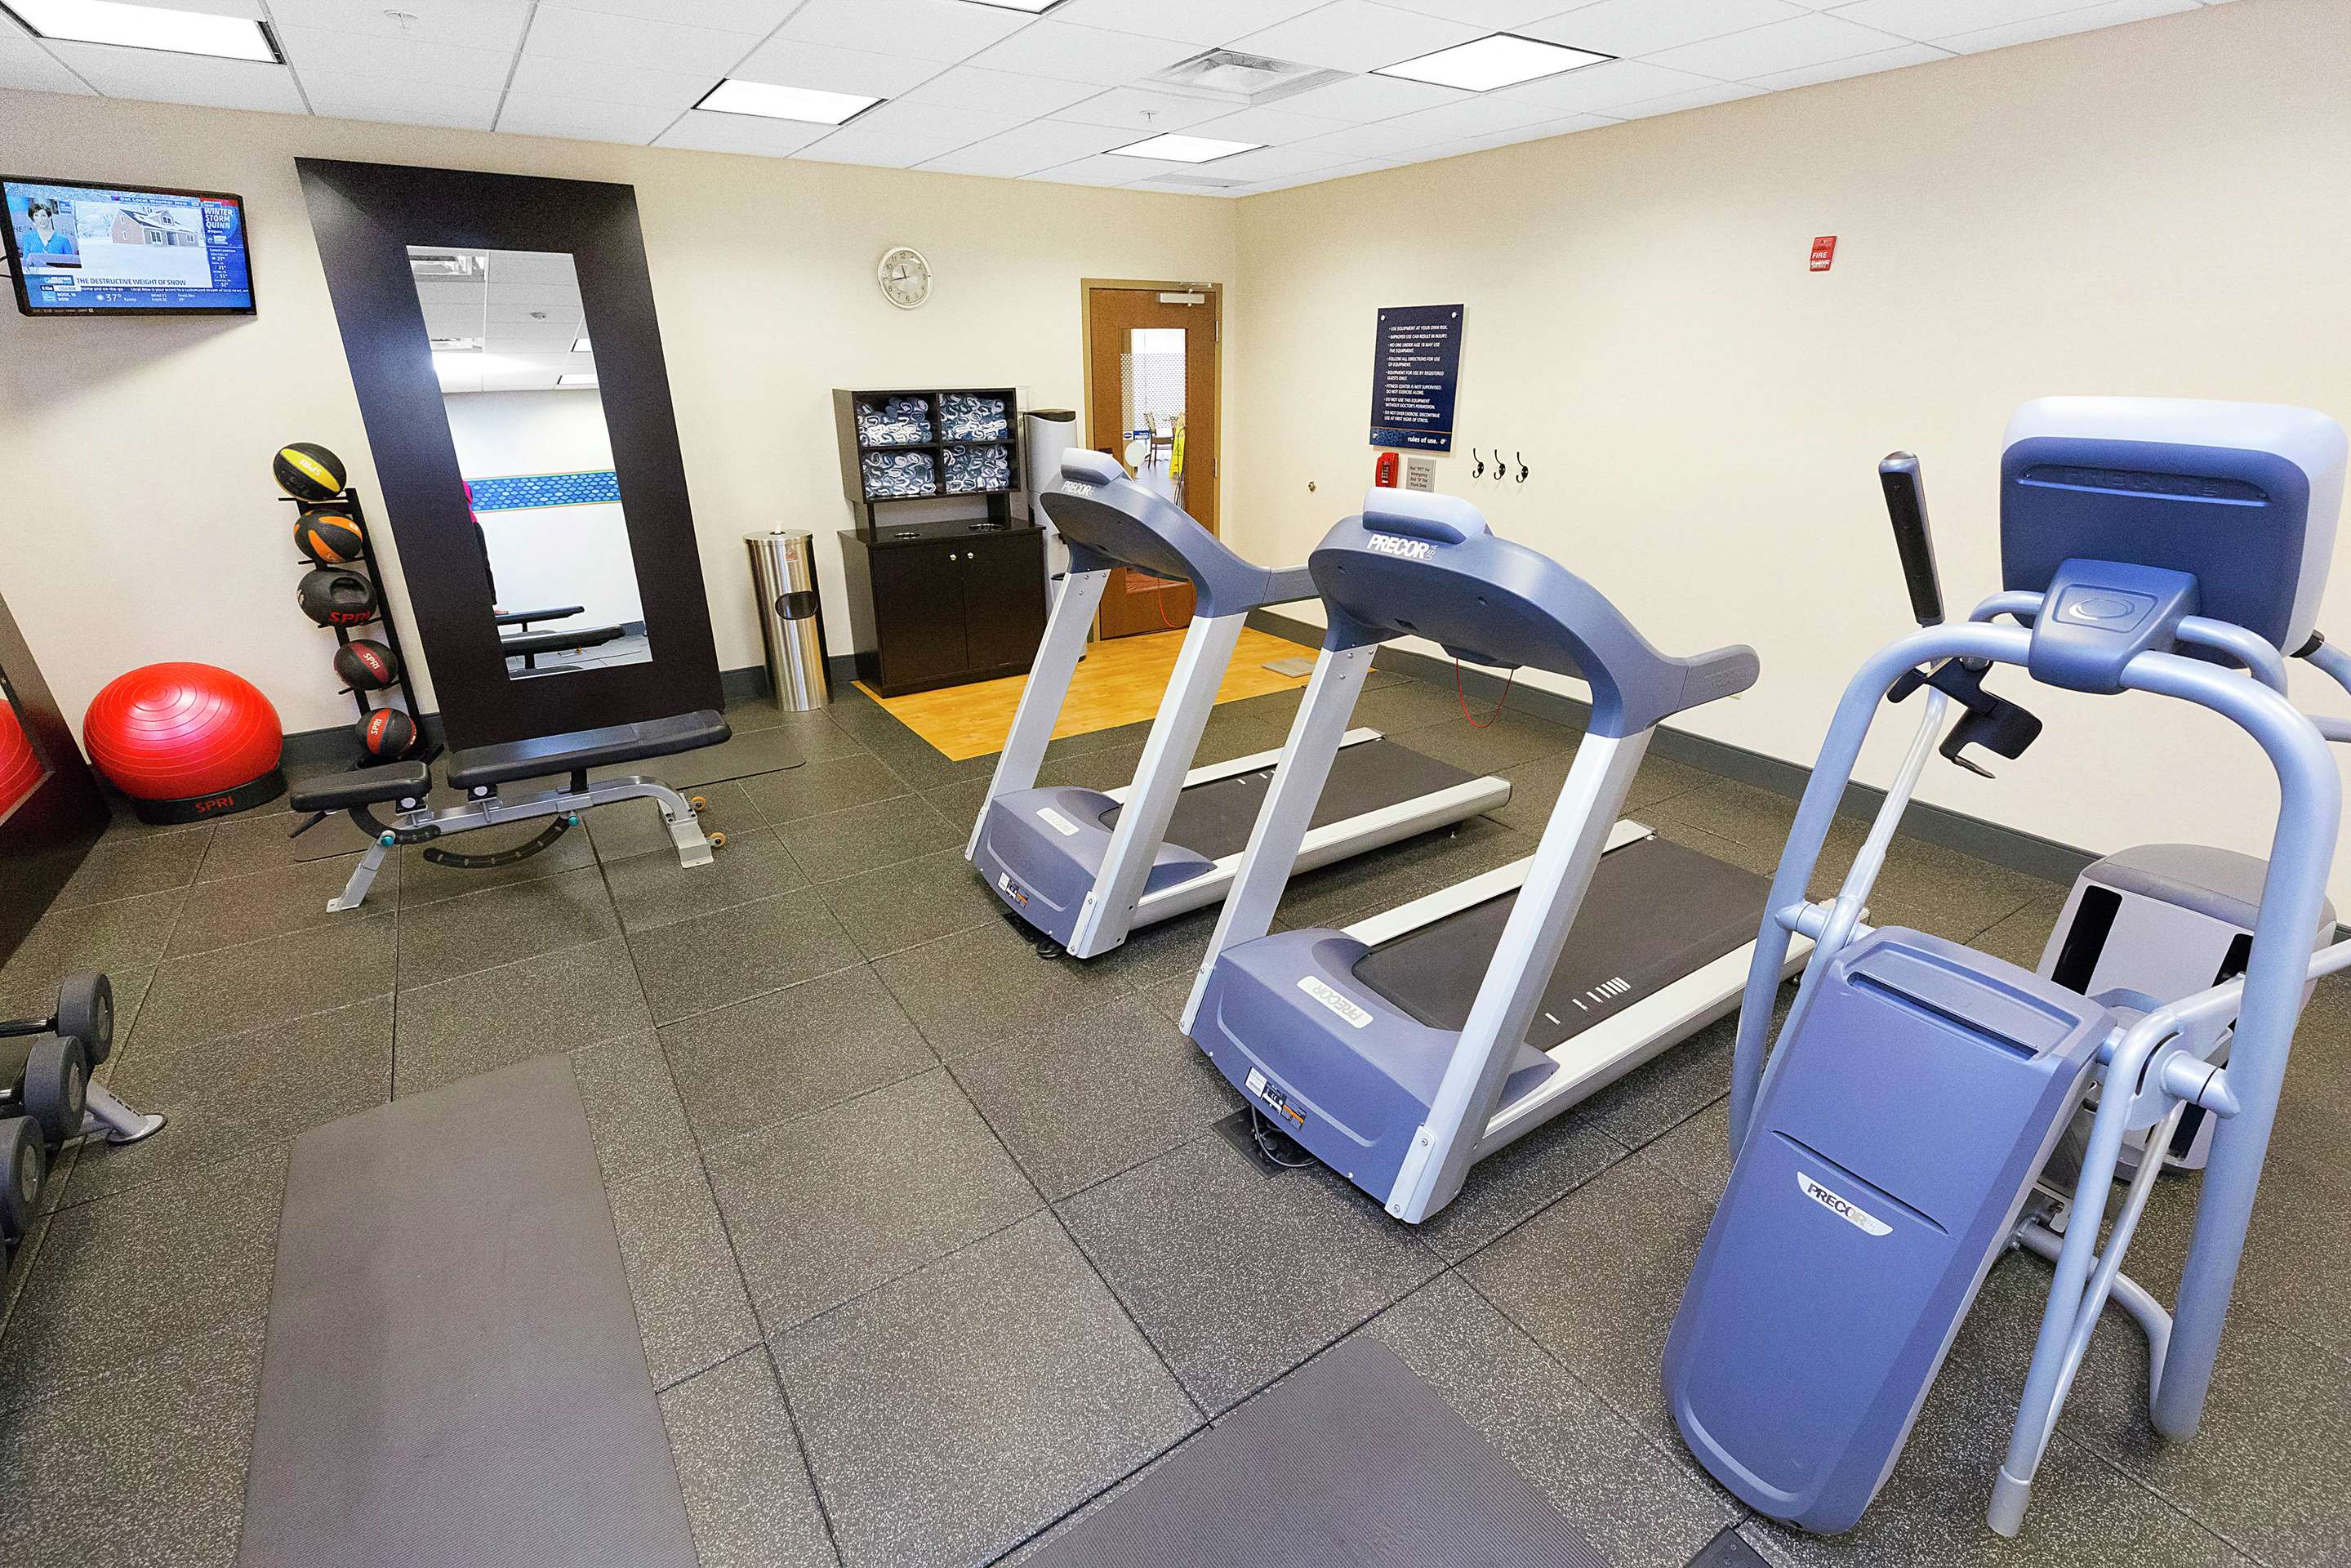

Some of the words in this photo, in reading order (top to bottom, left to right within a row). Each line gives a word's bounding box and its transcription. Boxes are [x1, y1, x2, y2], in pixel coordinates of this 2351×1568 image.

[204, 208, 232, 216] WINTER
[1061, 480, 1091, 497] PRECOR
[1367, 534, 1429, 559] PRECOR
[1424, 545, 1438, 561] USA
[363, 653, 381, 669] SPRI
[371, 719, 382, 735] SPRI
[195, 796, 234, 813] SPRI
[1311, 985, 1361, 1021] PRECOR
[1807, 1183, 1867, 1227] PRECOR
